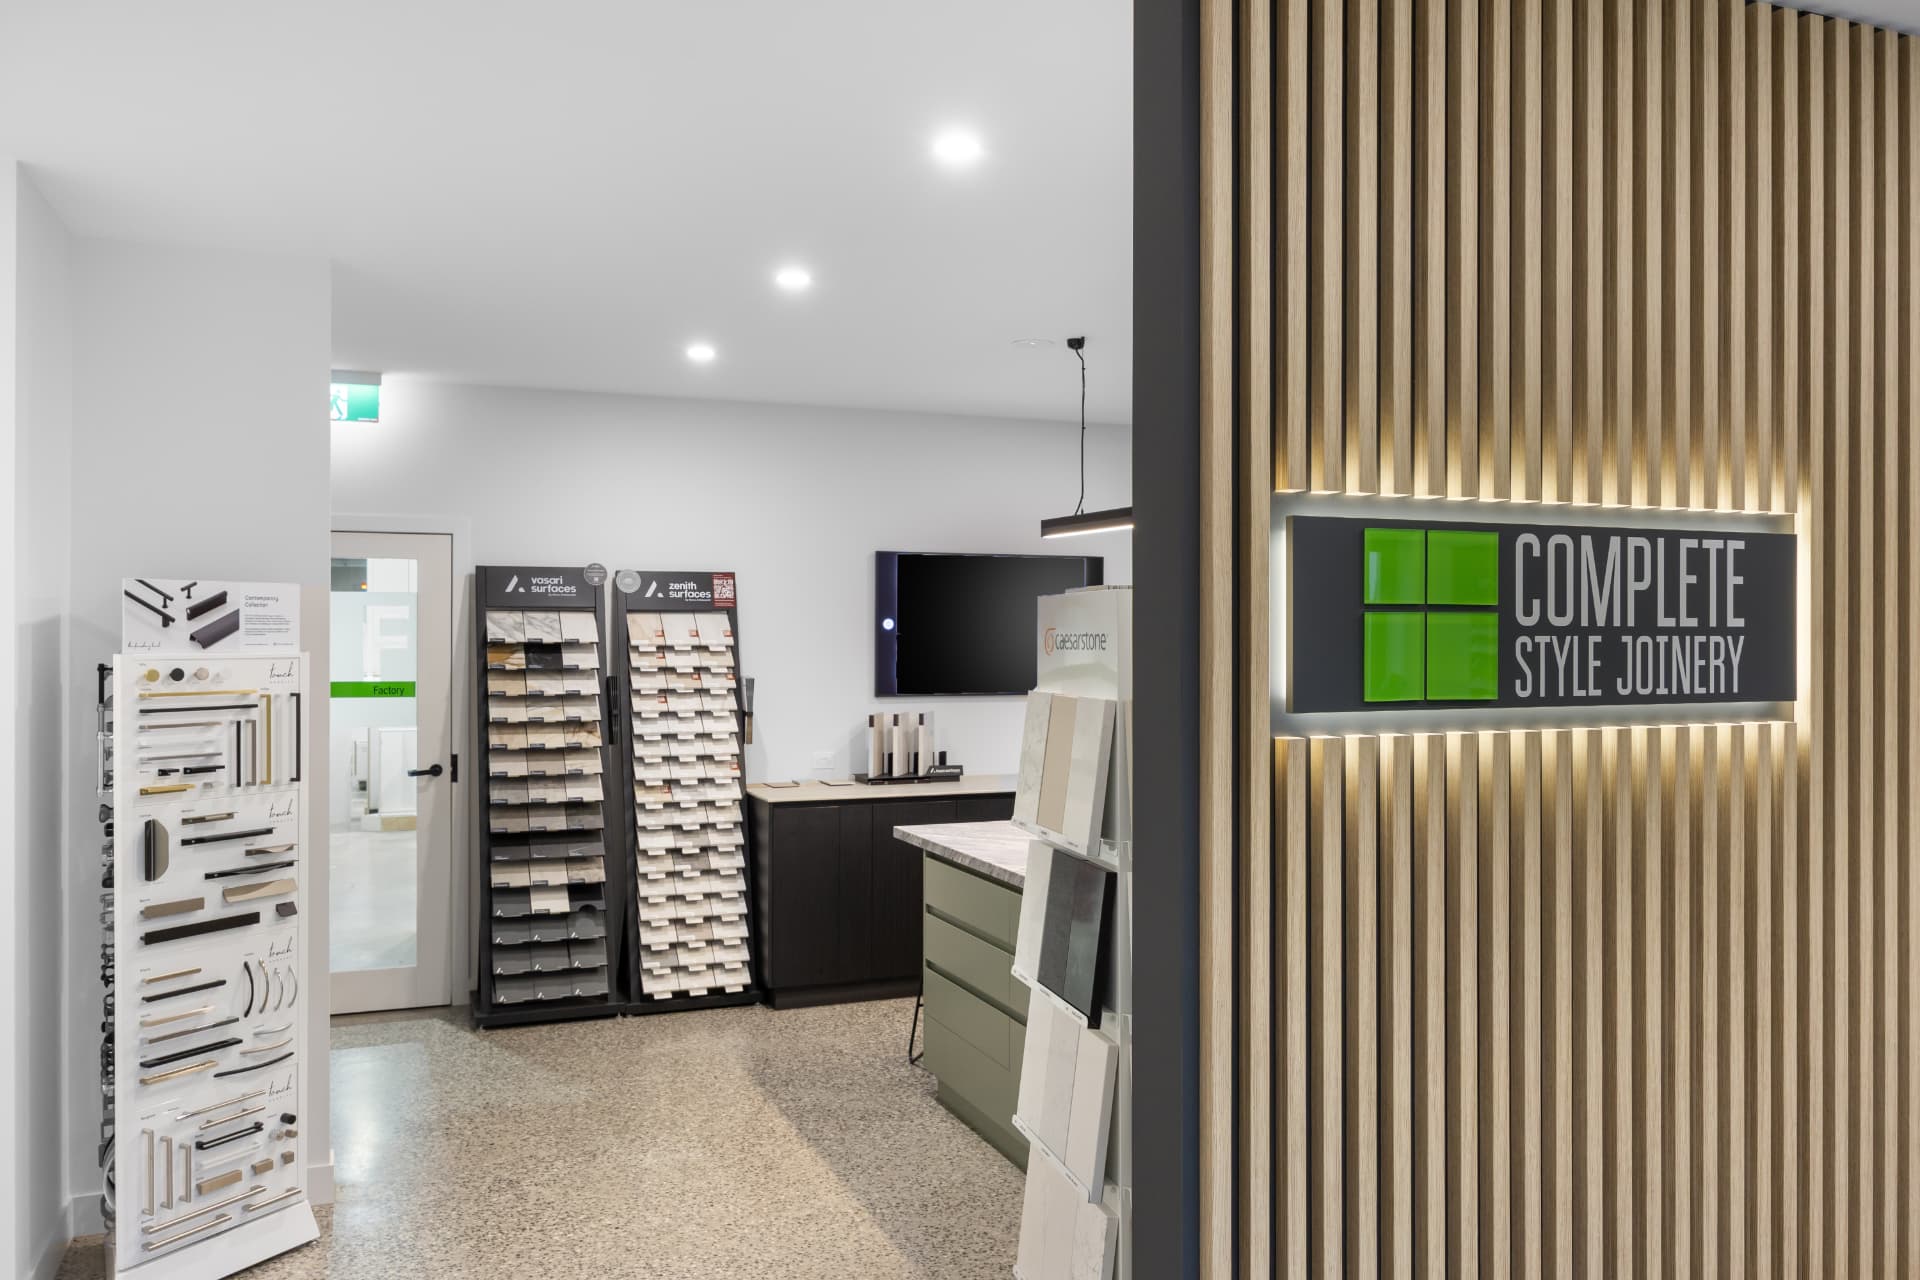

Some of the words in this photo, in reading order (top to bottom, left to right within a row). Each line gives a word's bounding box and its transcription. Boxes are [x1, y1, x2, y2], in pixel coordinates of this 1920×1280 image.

[531, 575, 563, 585] vasari
[668, 581, 697, 590] zenith
[1515, 533, 1745, 627] COMPLETE
[531, 584, 576, 593] surfaces
[668, 590, 711, 598] surfaces
[1055, 629, 1107, 651] caesarstone
[1515, 635, 1602, 698] STYLE
[1616, 635, 1745, 696] JOINERY
[373, 685, 405, 697] Factory
